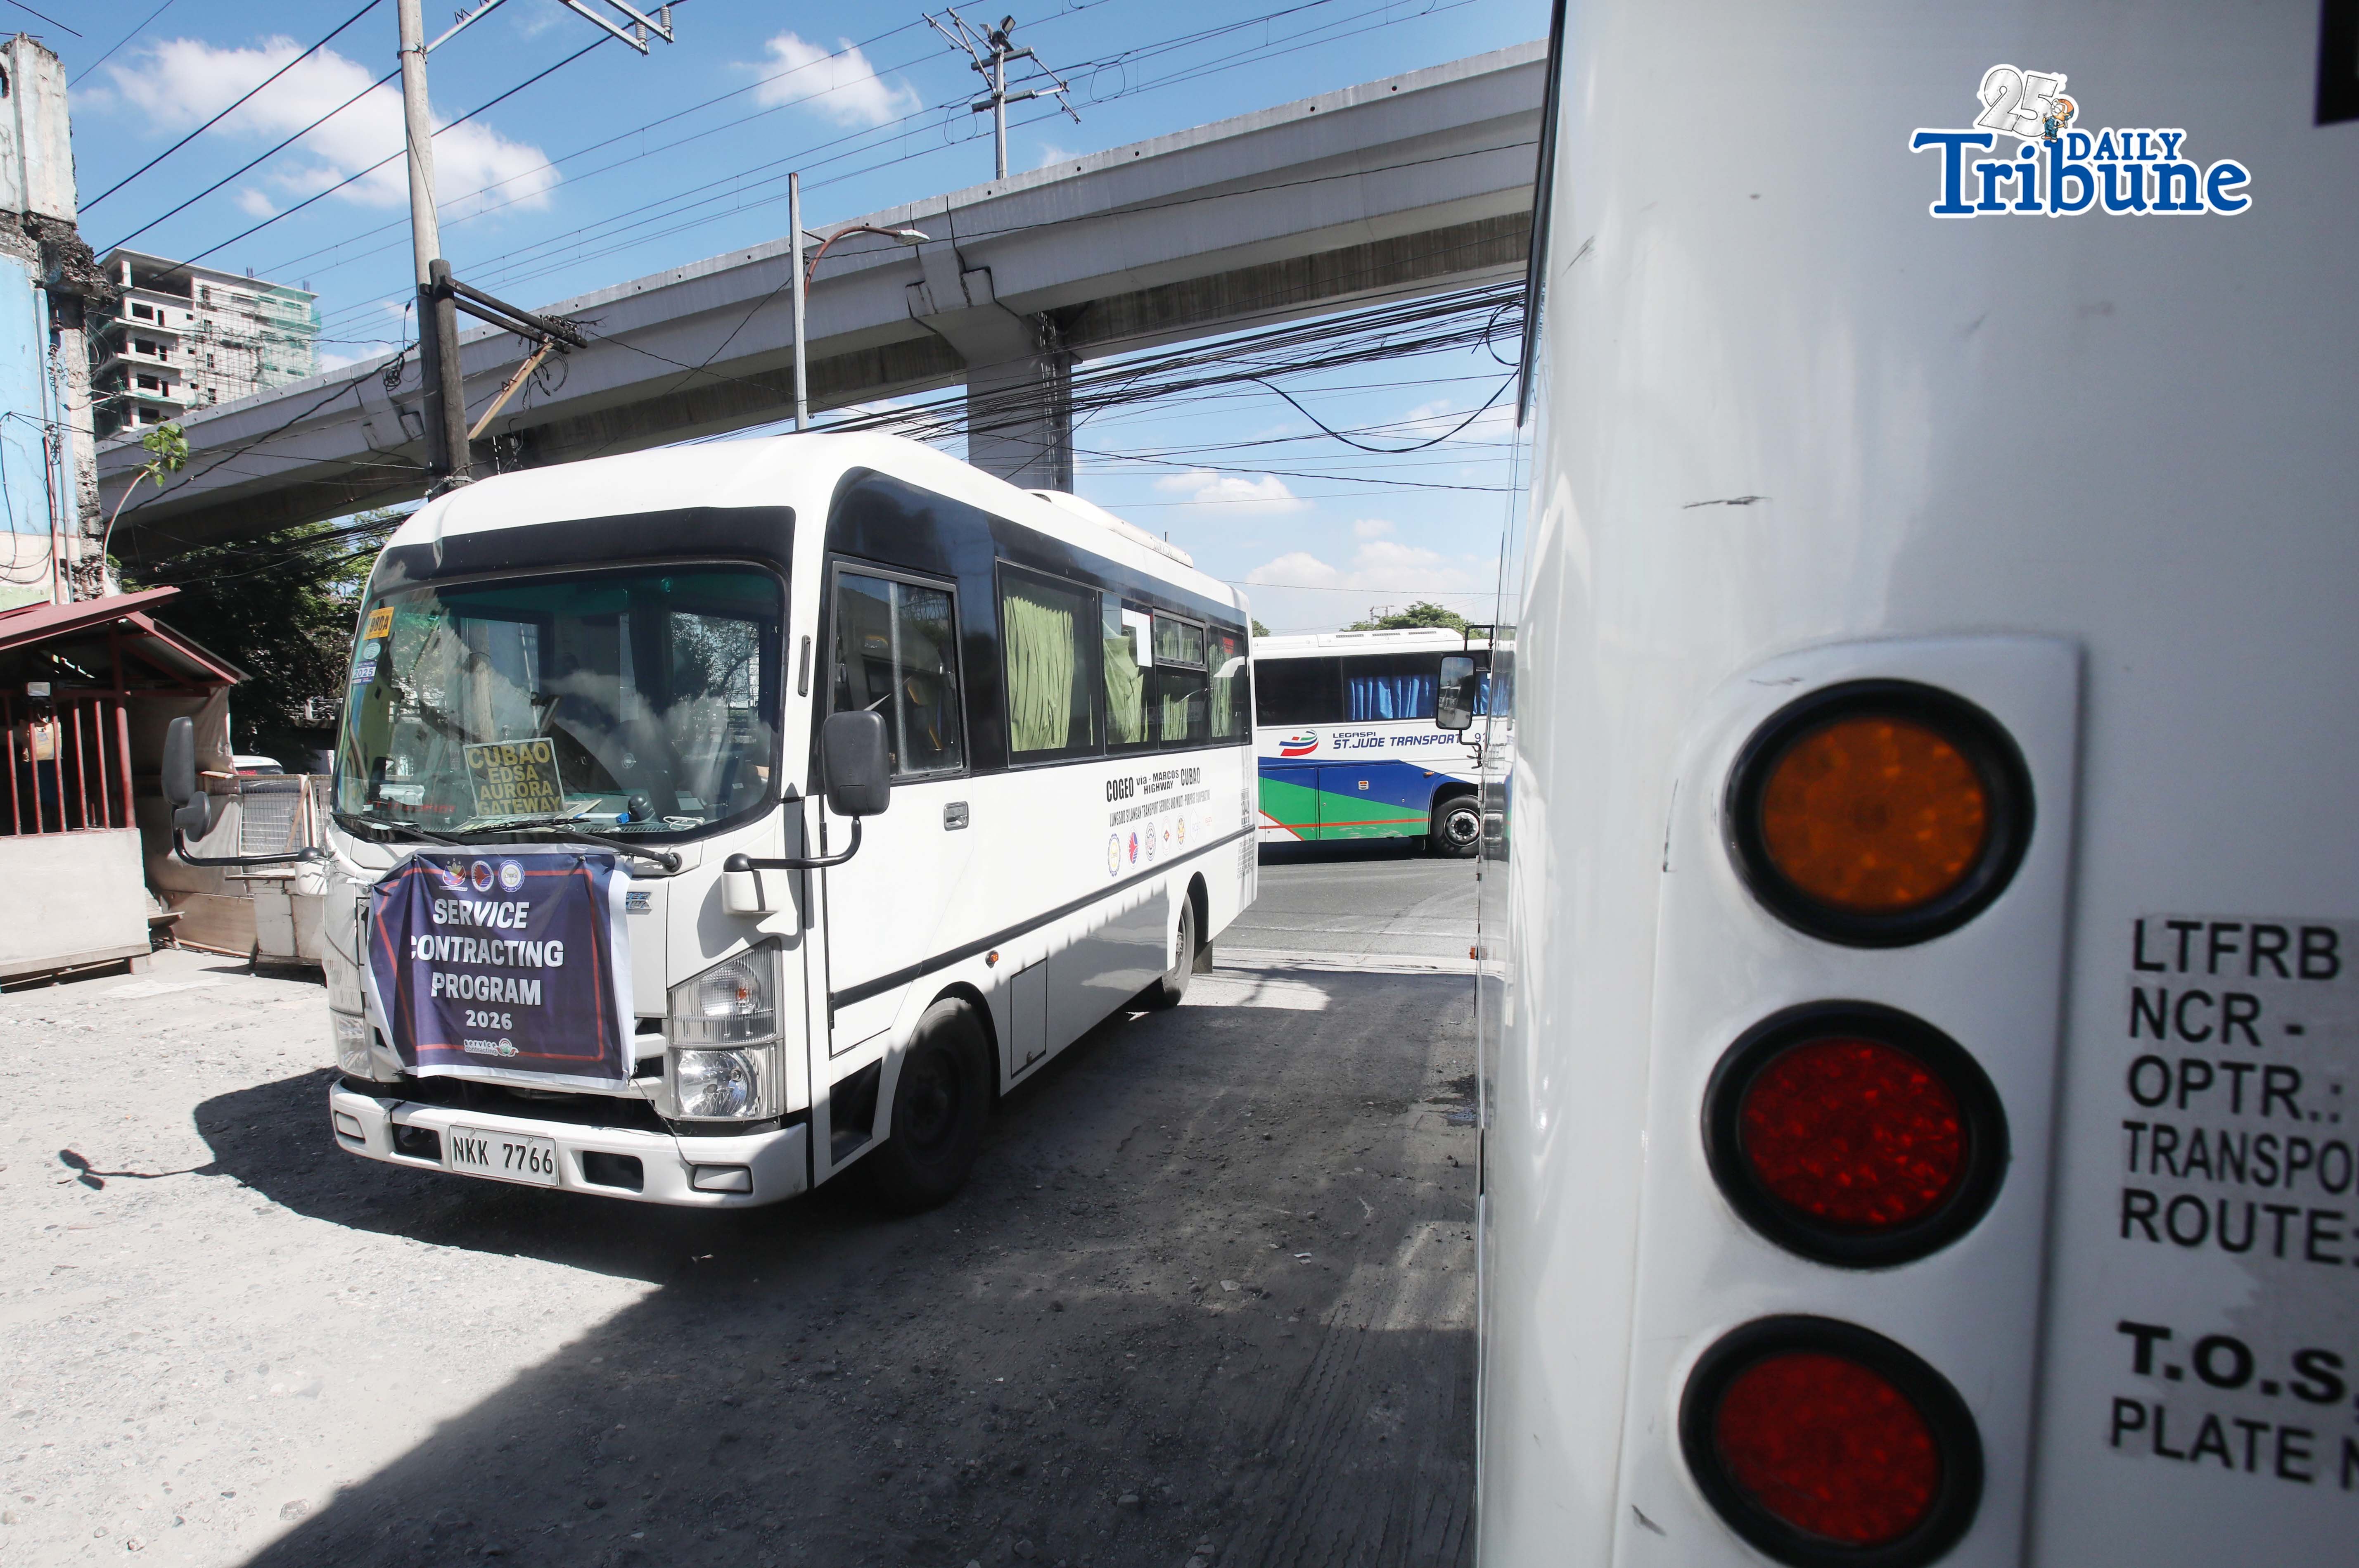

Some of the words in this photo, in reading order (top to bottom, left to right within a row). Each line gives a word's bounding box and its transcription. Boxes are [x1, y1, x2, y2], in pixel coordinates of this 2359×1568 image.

[353, 668, 374, 678] 2025
[1390, 733, 1462, 747] TRANSPORT
[467, 742, 550, 769] CUBAO
[487, 764, 539, 784] EDSA
[1106, 776, 1134, 802] COGEO
[1136, 776, 1147, 785] via
[1152, 769, 1179, 782] MARCOS
[1144, 780, 1173, 795] HIGHWAY
[1181, 767, 1200, 786] CUBAO
[480, 780, 554, 800] AURORA
[478, 796, 560, 816] GATEWAY
[1110, 810, 1125, 827] LUNGSOD
[1126, 805, 1141, 823] SILANGAN
[1142, 801, 1159, 817] TRANSPORT
[1159, 797, 1170, 812] SERVICE
[432, 898, 530, 929] SERVICE
[2132, 918, 2341, 982] LTFRB
[431, 972, 541, 1006] PROGRAM
[466, 1010, 512, 1030] 2026
[2129, 986, 2263, 1048] NCR
[465, 1046, 497, 1055] contracting
[454, 1136, 490, 1166] NKK
[503, 1143, 553, 1174] 7766
[2122, 1120, 2359, 1196] TRANSPO
[2109, 1395, 2316, 1485] PLATE
